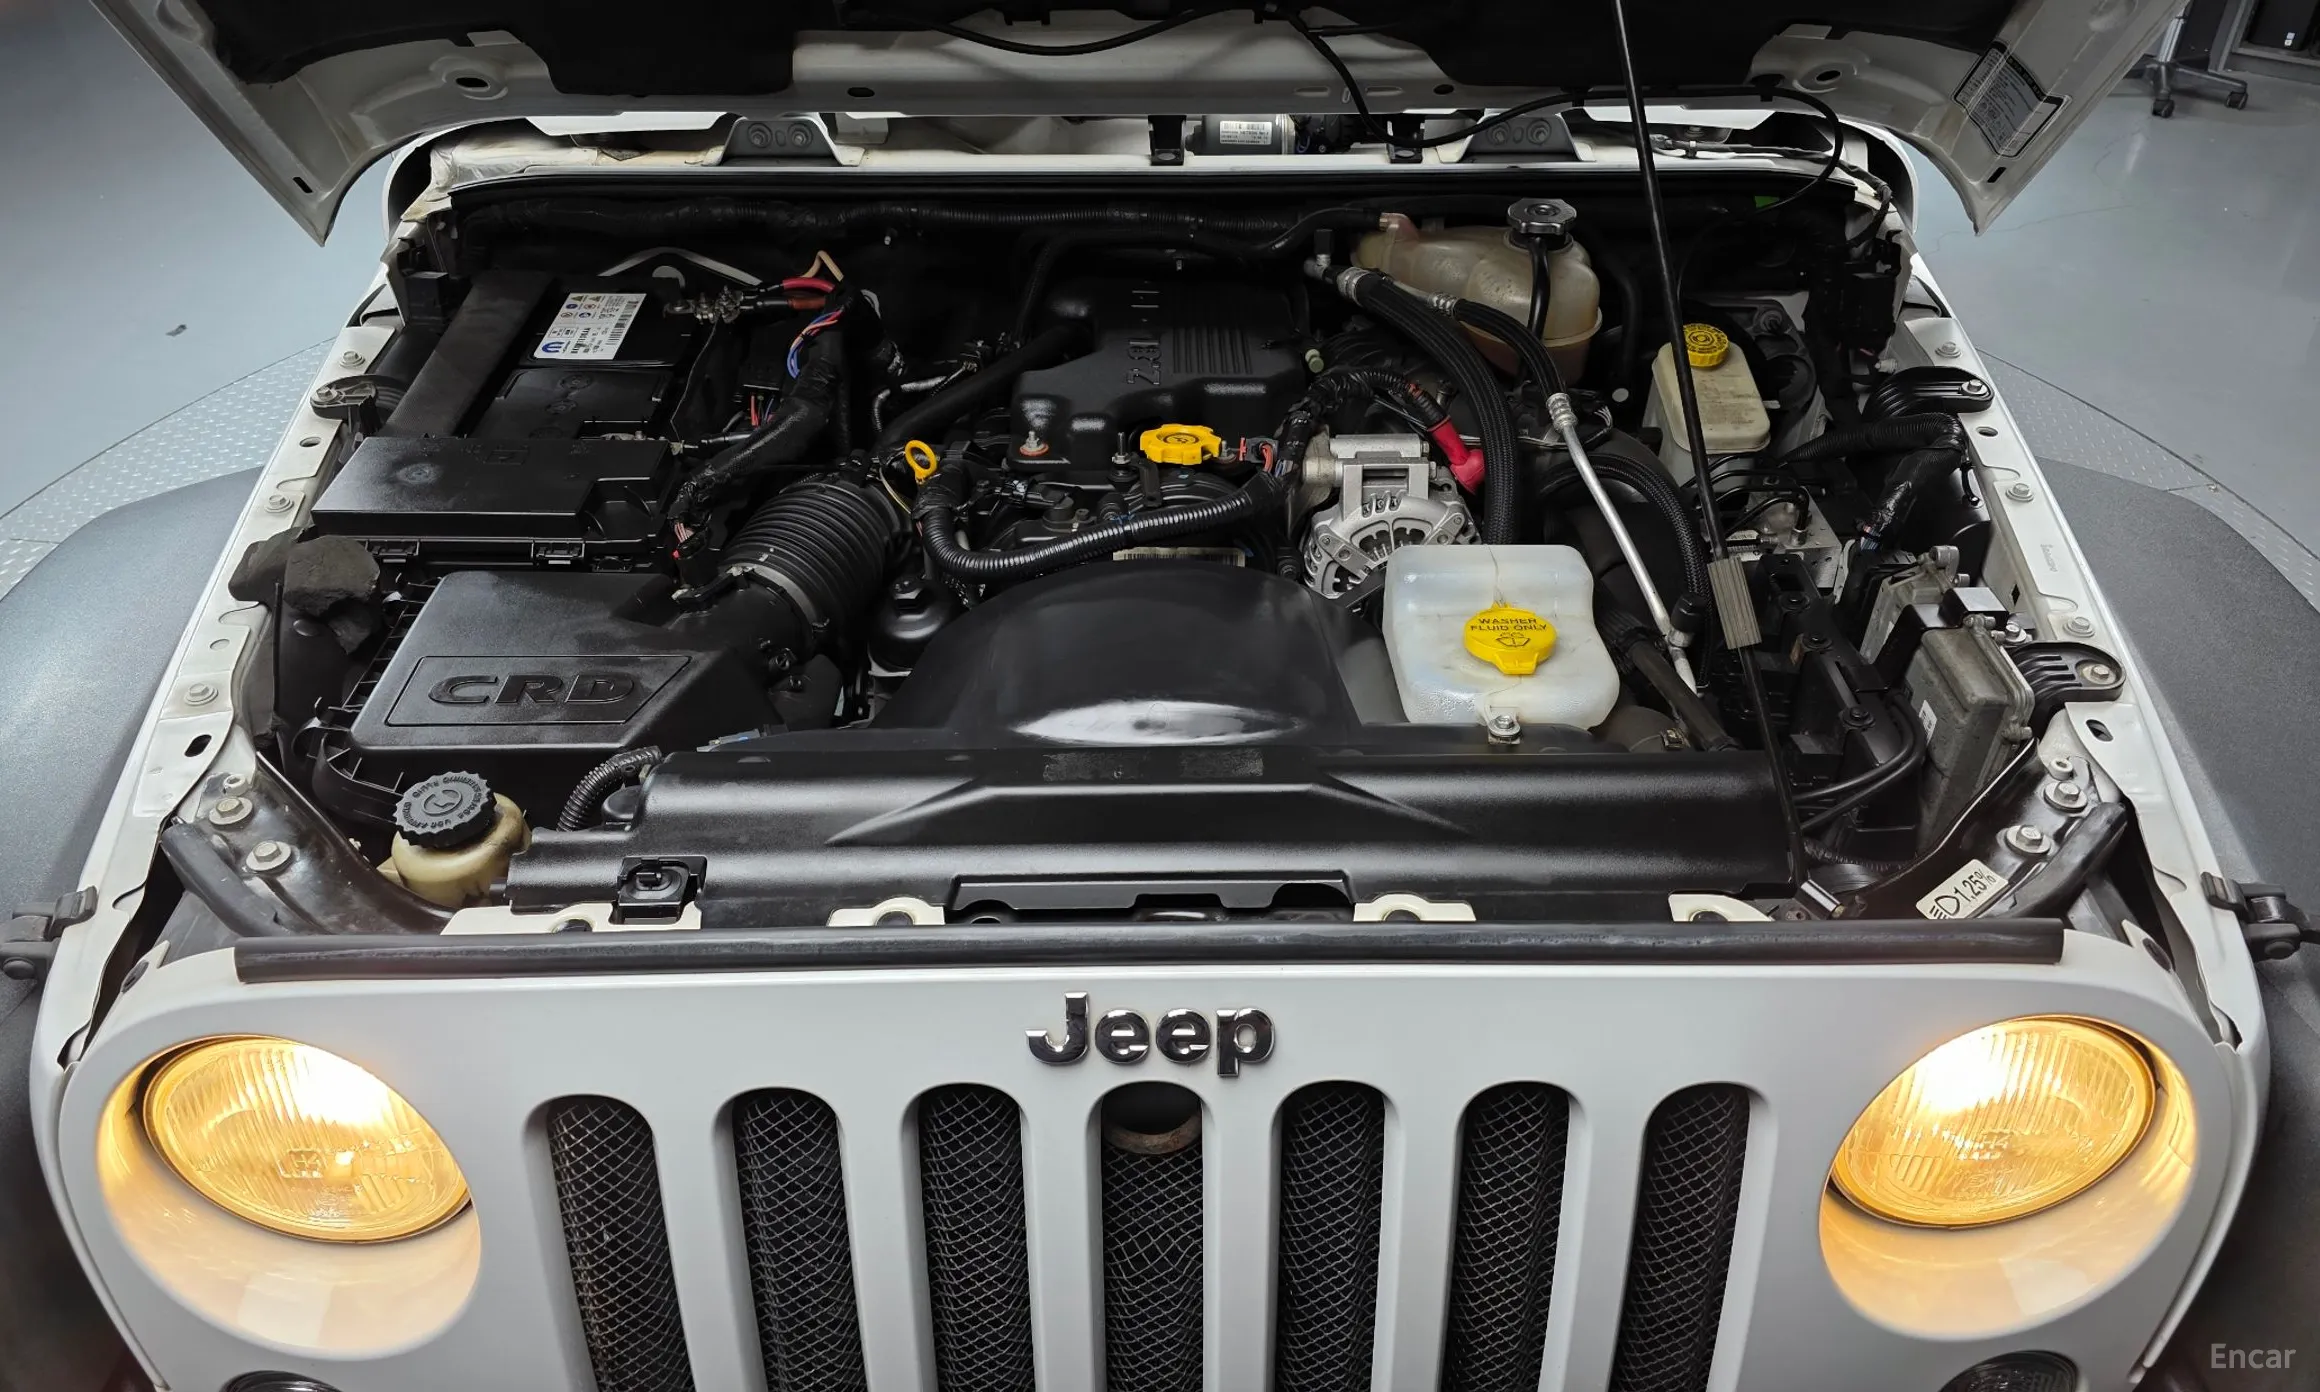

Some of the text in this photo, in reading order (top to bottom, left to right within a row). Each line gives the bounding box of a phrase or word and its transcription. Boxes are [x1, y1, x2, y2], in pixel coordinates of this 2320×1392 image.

[428, 674, 636, 704] CRD
[1954, 868, 1997, 902] 1,25%
[1025, 991, 1276, 1077] Jeep
